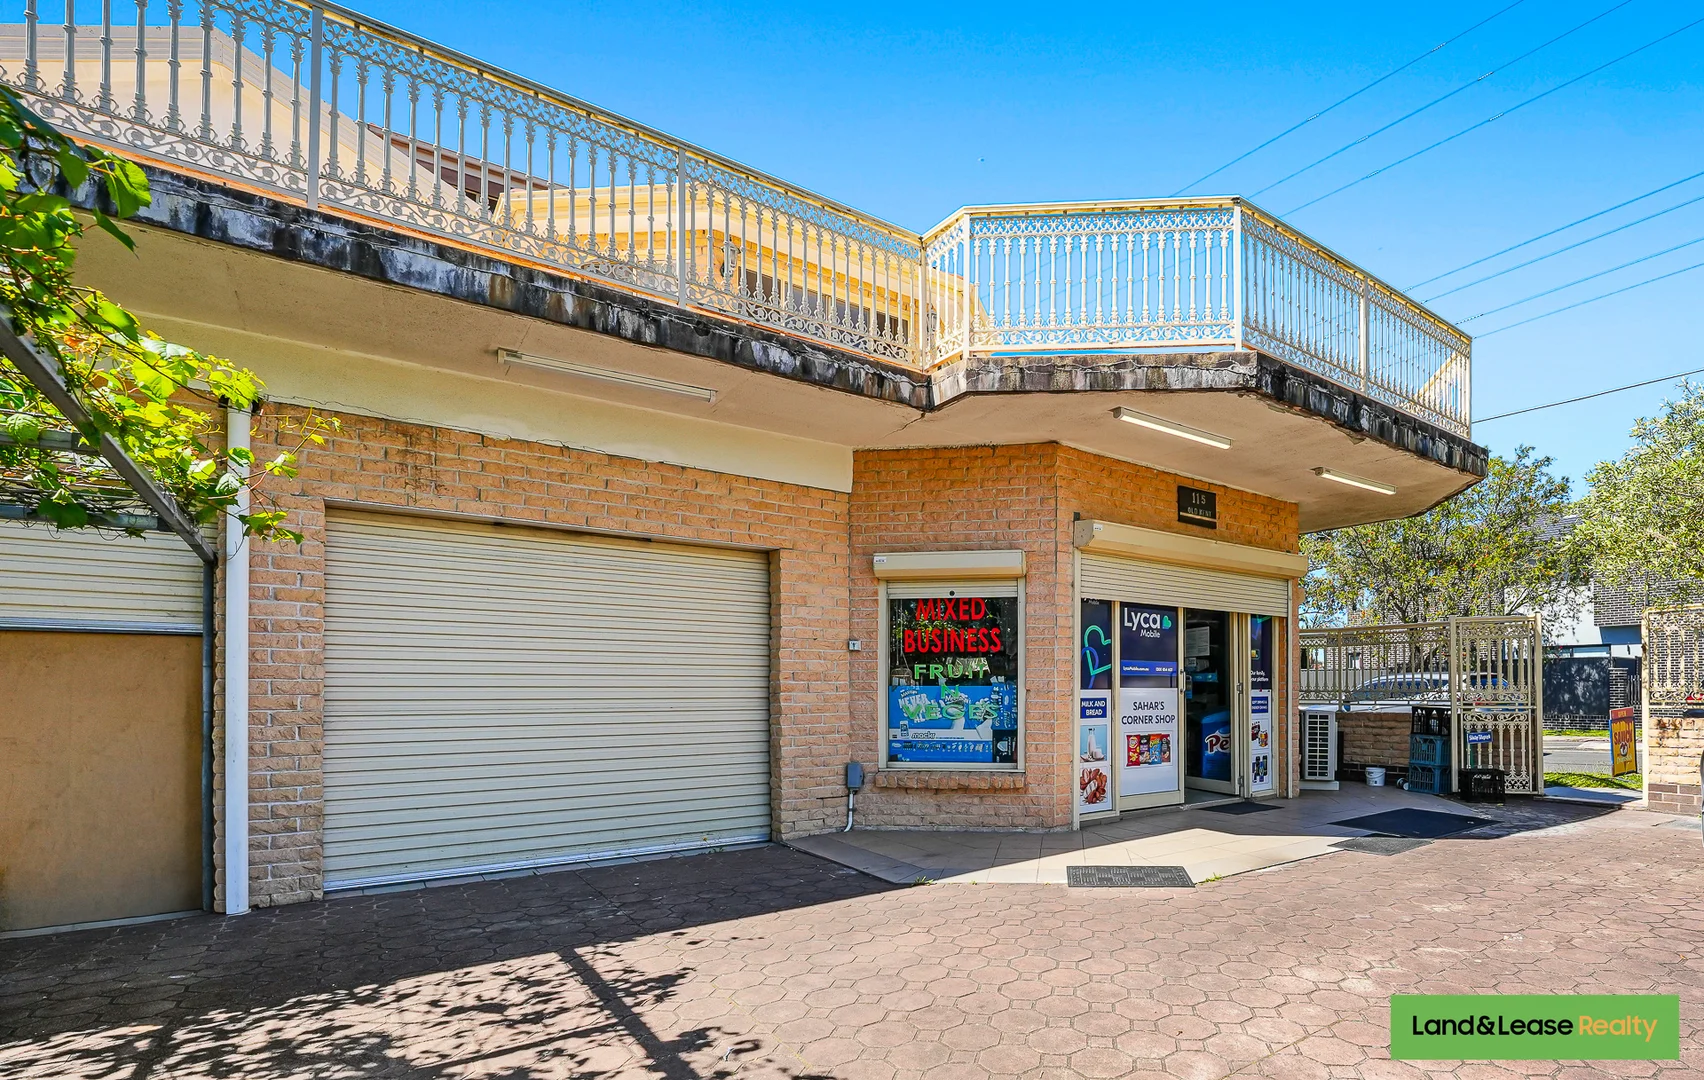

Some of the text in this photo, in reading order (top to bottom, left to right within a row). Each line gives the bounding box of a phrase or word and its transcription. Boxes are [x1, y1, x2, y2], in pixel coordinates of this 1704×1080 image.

[1192, 492, 1206, 504] 115
[915, 597, 986, 620] MIXED
[1124, 607, 1160, 631] Lyca
[904, 627, 1001, 653] BUSINESS
[1140, 629, 1161, 638] Mobile
[914, 663, 984, 680] FRUIT
[940, 684, 960, 698] N
[902, 702, 998, 720] VEGES
[1085, 708, 1103, 716] BREAD
[1133, 701, 1165, 711] SAHAR'S
[1121, 714, 1175, 725] CORNER SHOP
